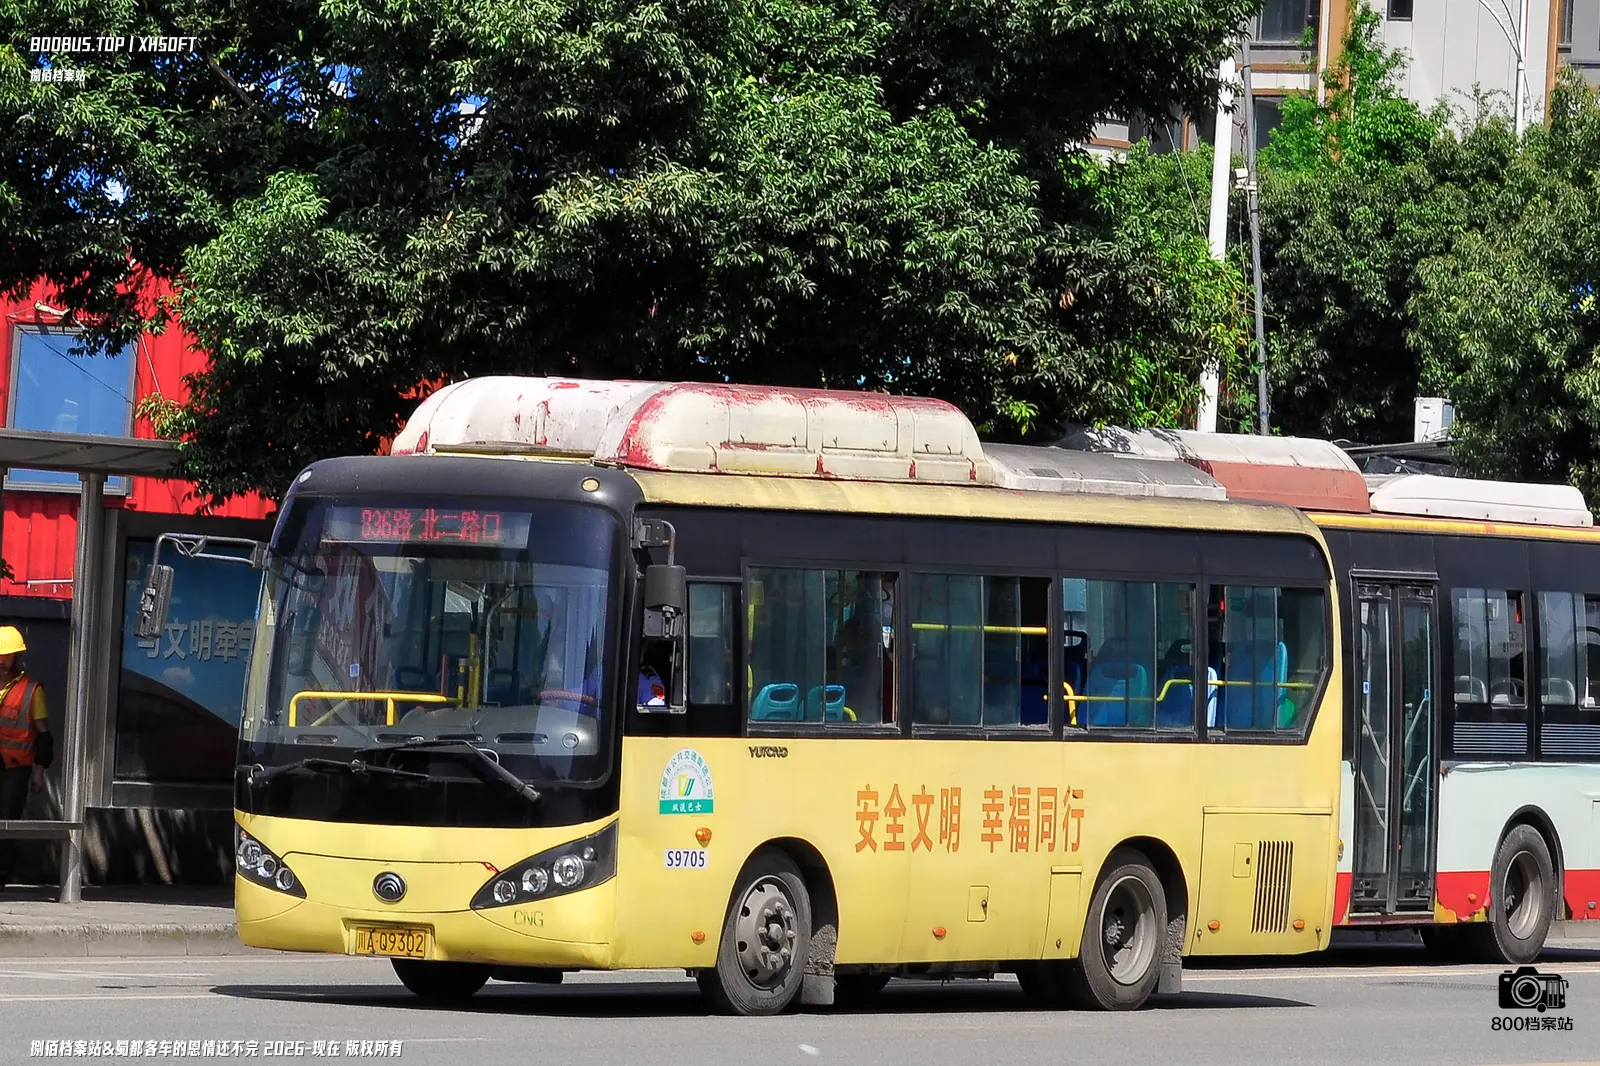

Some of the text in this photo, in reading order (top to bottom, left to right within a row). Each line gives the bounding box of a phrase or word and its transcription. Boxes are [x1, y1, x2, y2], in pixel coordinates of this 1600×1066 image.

[361, 508, 500, 542] 836路 北二路口
[855, 783, 1084, 853] 安全文明 幸福同行
[667, 850, 705, 867] S9705
[514, 910, 544, 927] CNG
